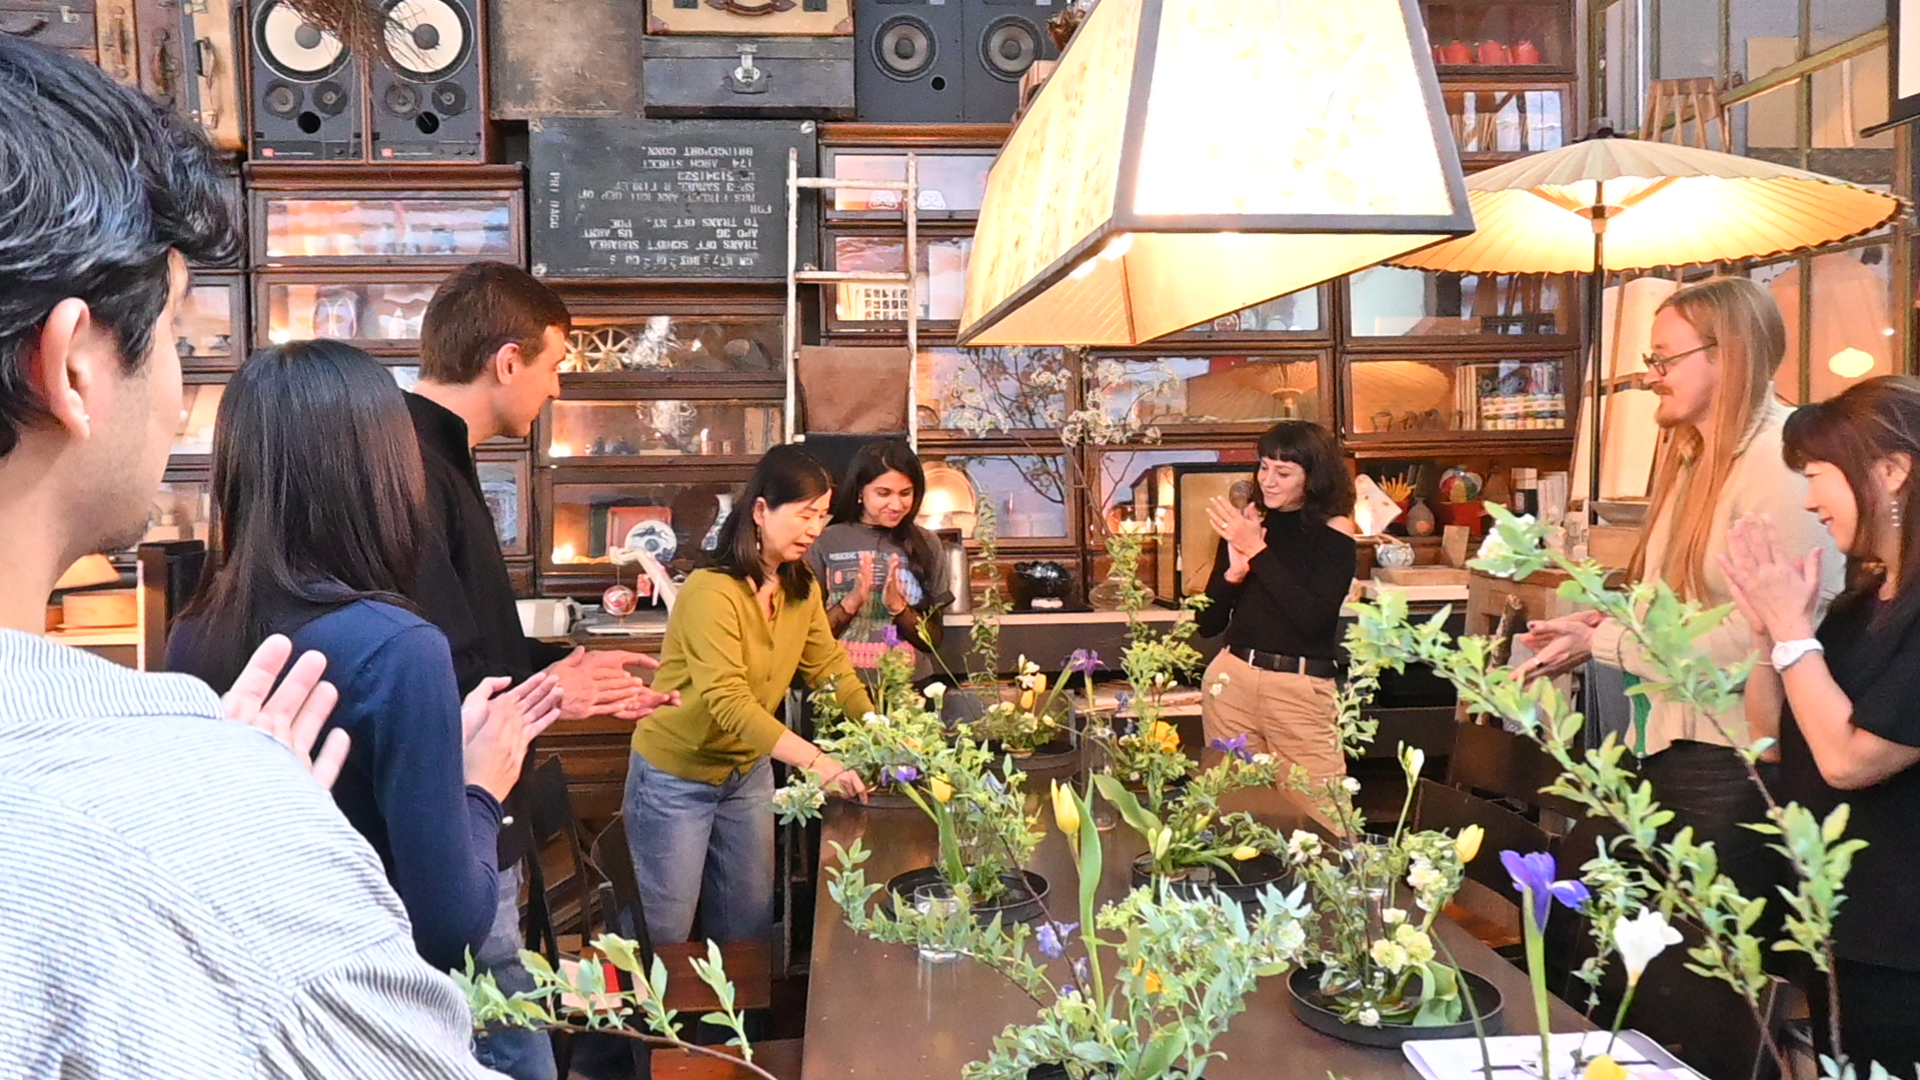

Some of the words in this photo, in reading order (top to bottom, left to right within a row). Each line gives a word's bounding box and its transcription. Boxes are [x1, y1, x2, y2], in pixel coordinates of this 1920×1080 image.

[683, 146, 753, 156] BRIDGEPORT
[690, 159, 718, 168] ARCH
[731, 159, 752, 167] 174
[702, 218, 737, 228] TRANS
[744, 218, 758, 227] TO
[617, 229, 632, 238] US
[723, 240, 758, 250] TRANS
